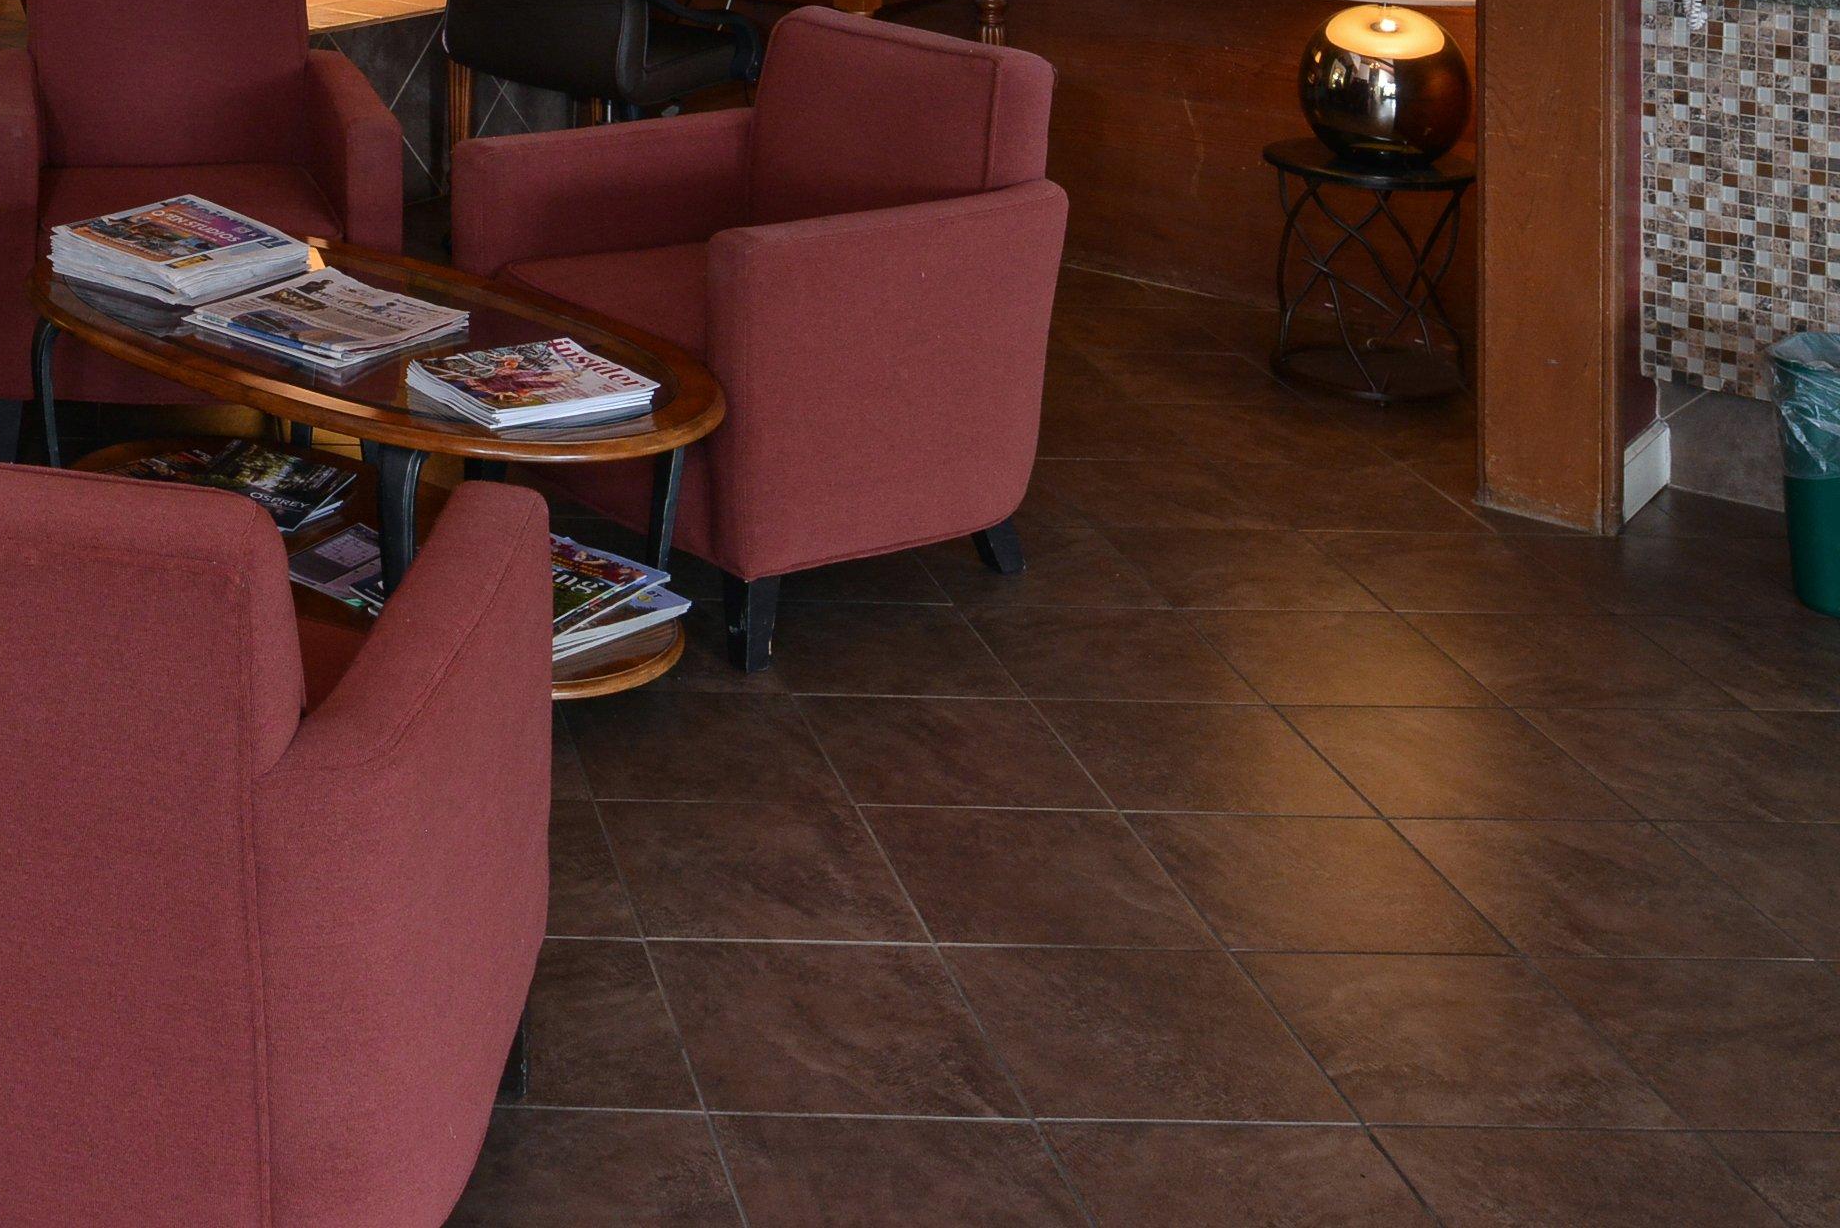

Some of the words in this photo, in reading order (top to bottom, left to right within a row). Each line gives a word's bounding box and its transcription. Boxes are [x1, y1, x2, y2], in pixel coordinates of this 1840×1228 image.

[184, 220, 241, 243] STUDIOS
[549, 338, 647, 389] insider
[249, 491, 312, 510] OSPREY
[552, 567, 605, 595] ing
